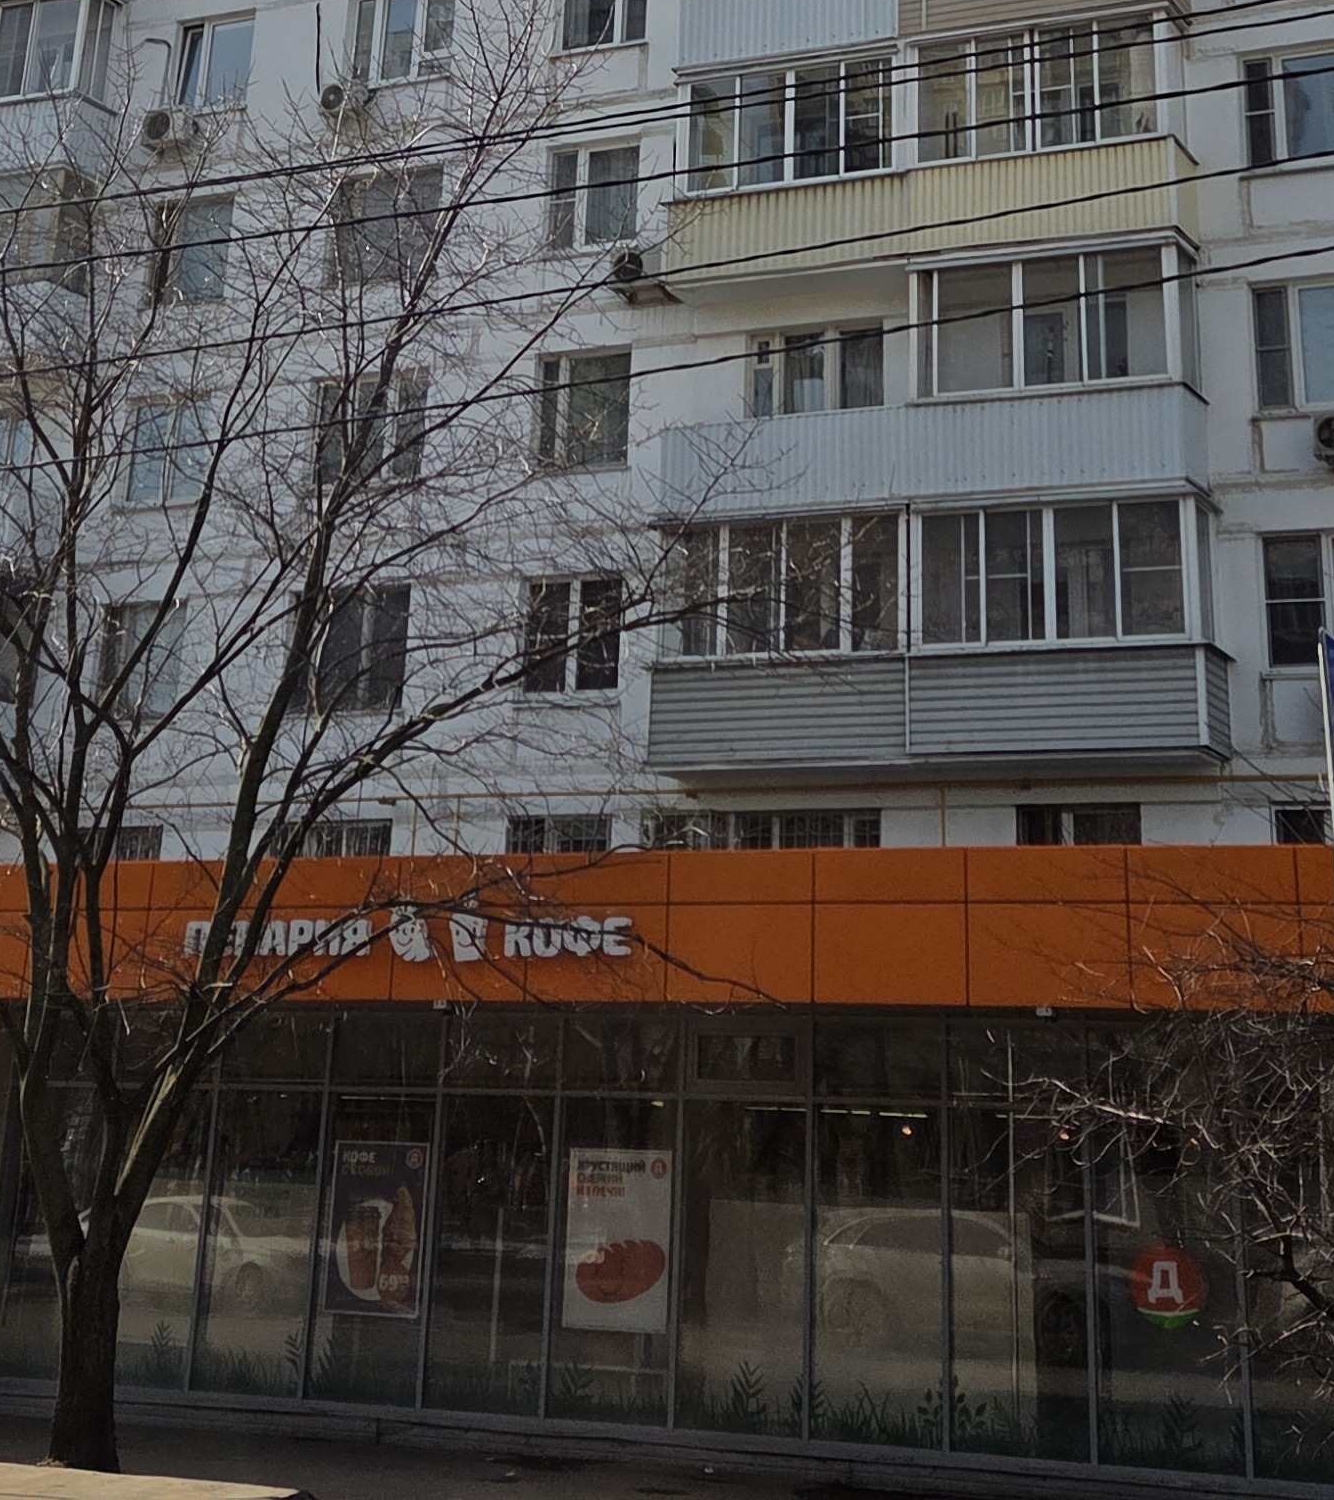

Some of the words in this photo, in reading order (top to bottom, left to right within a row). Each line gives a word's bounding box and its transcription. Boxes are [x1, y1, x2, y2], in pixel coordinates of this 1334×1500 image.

[503, 915, 633, 957] КОФЕ
[342, 1150, 377, 1164] КОФЕ
[1146, 1260, 1185, 1305] Д
